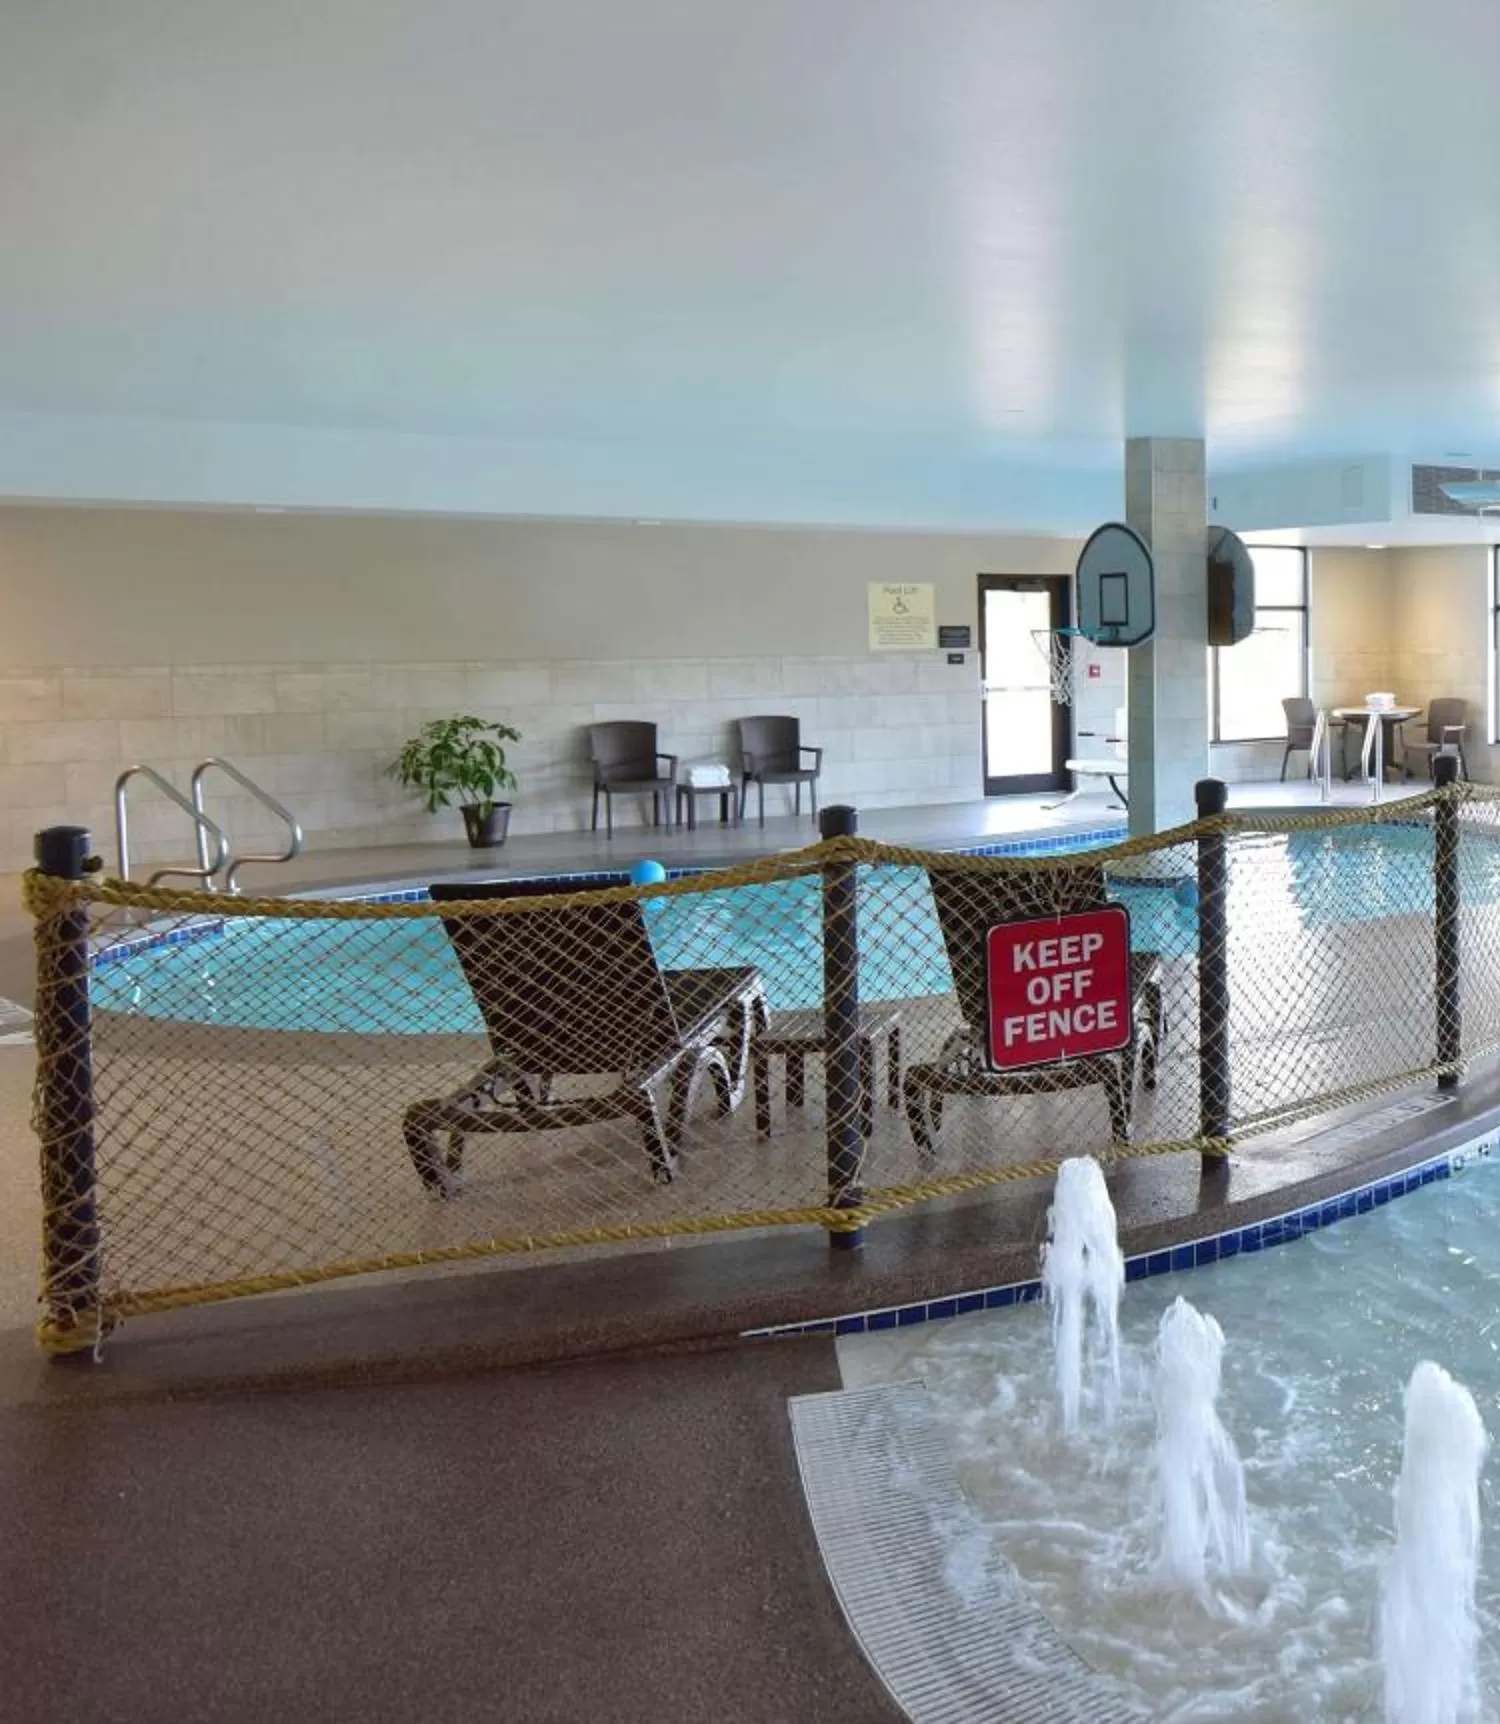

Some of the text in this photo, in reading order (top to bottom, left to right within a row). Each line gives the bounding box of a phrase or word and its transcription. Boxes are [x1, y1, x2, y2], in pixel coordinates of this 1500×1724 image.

[1012, 933, 1104, 973] KEEP
[1027, 969, 1094, 1005] OFF
[1004, 1000, 1118, 1047] FENCE
